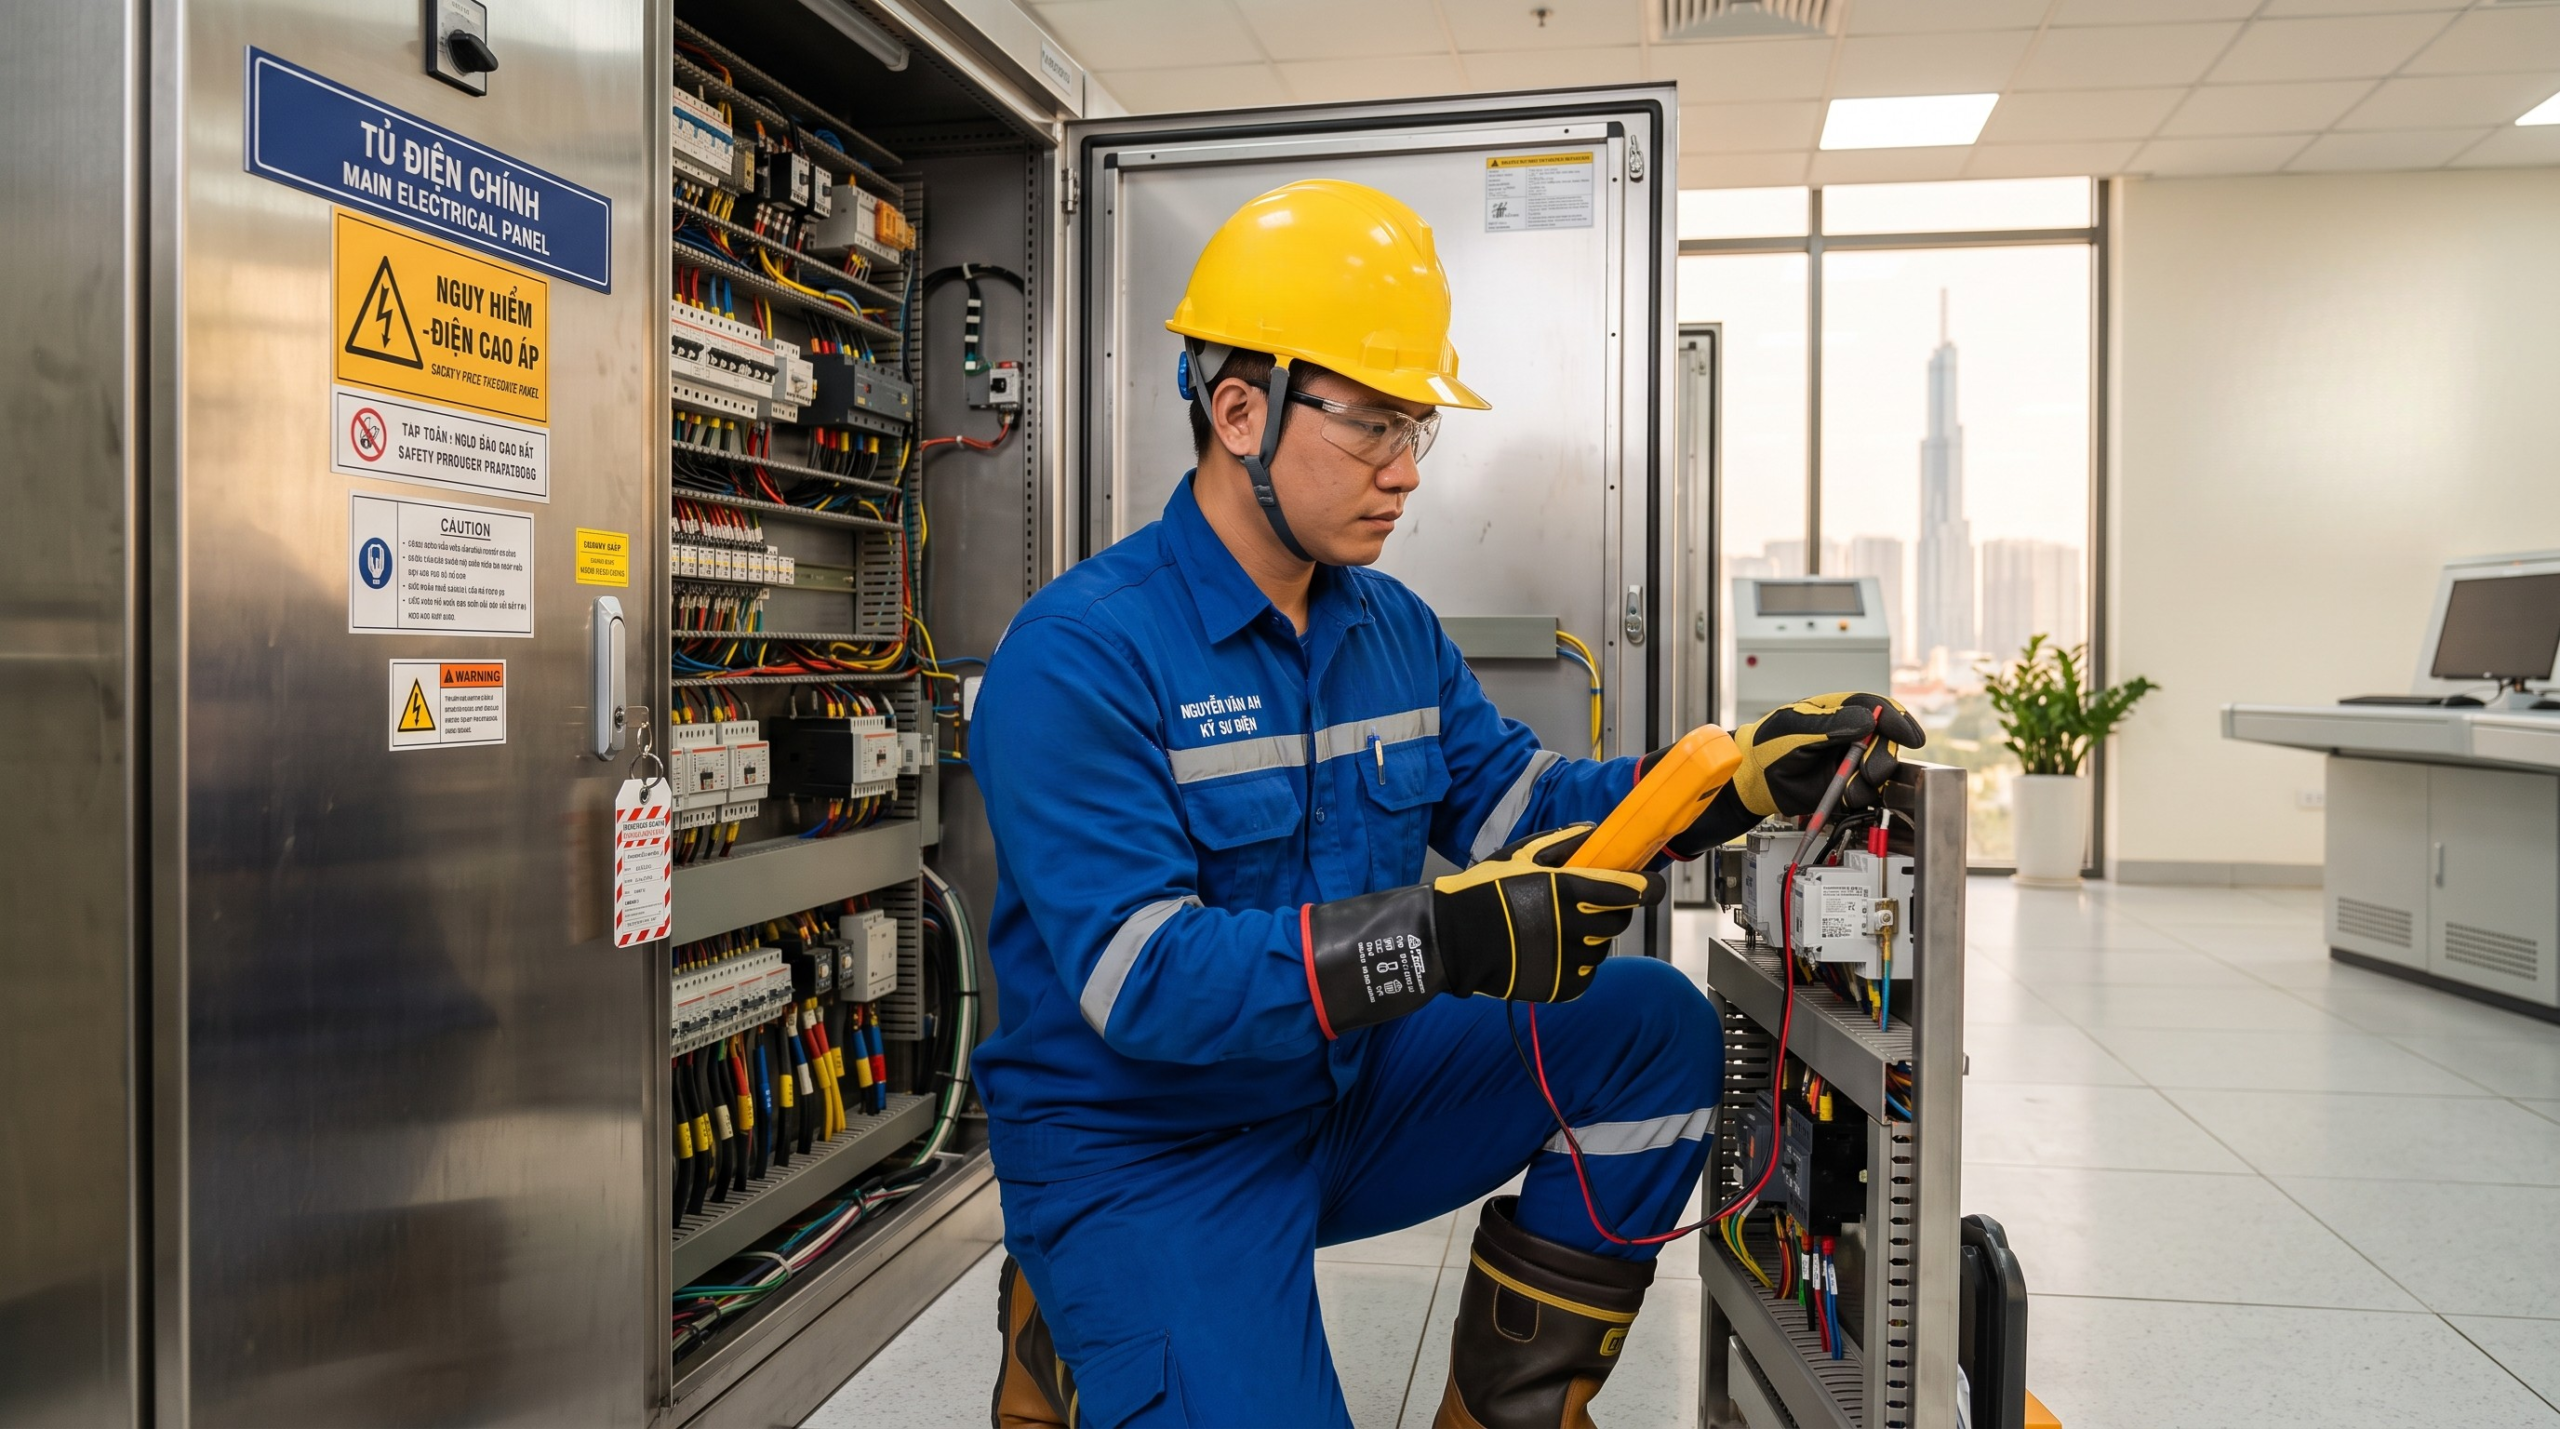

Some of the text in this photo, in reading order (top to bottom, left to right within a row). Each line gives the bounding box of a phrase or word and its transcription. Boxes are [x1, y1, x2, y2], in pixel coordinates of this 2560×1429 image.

[361, 117, 539, 221] TỦ ĐIỆN CHÍNH
[343, 161, 550, 256] MAIN ELECTRICAL PANEL
[437, 275, 485, 314] NGUY
[479, 331, 513, 365] CAO
[518, 336, 539, 370] ÁP
[398, 445, 434, 464] SAFETY
[455, 671, 500, 682] WARNING
